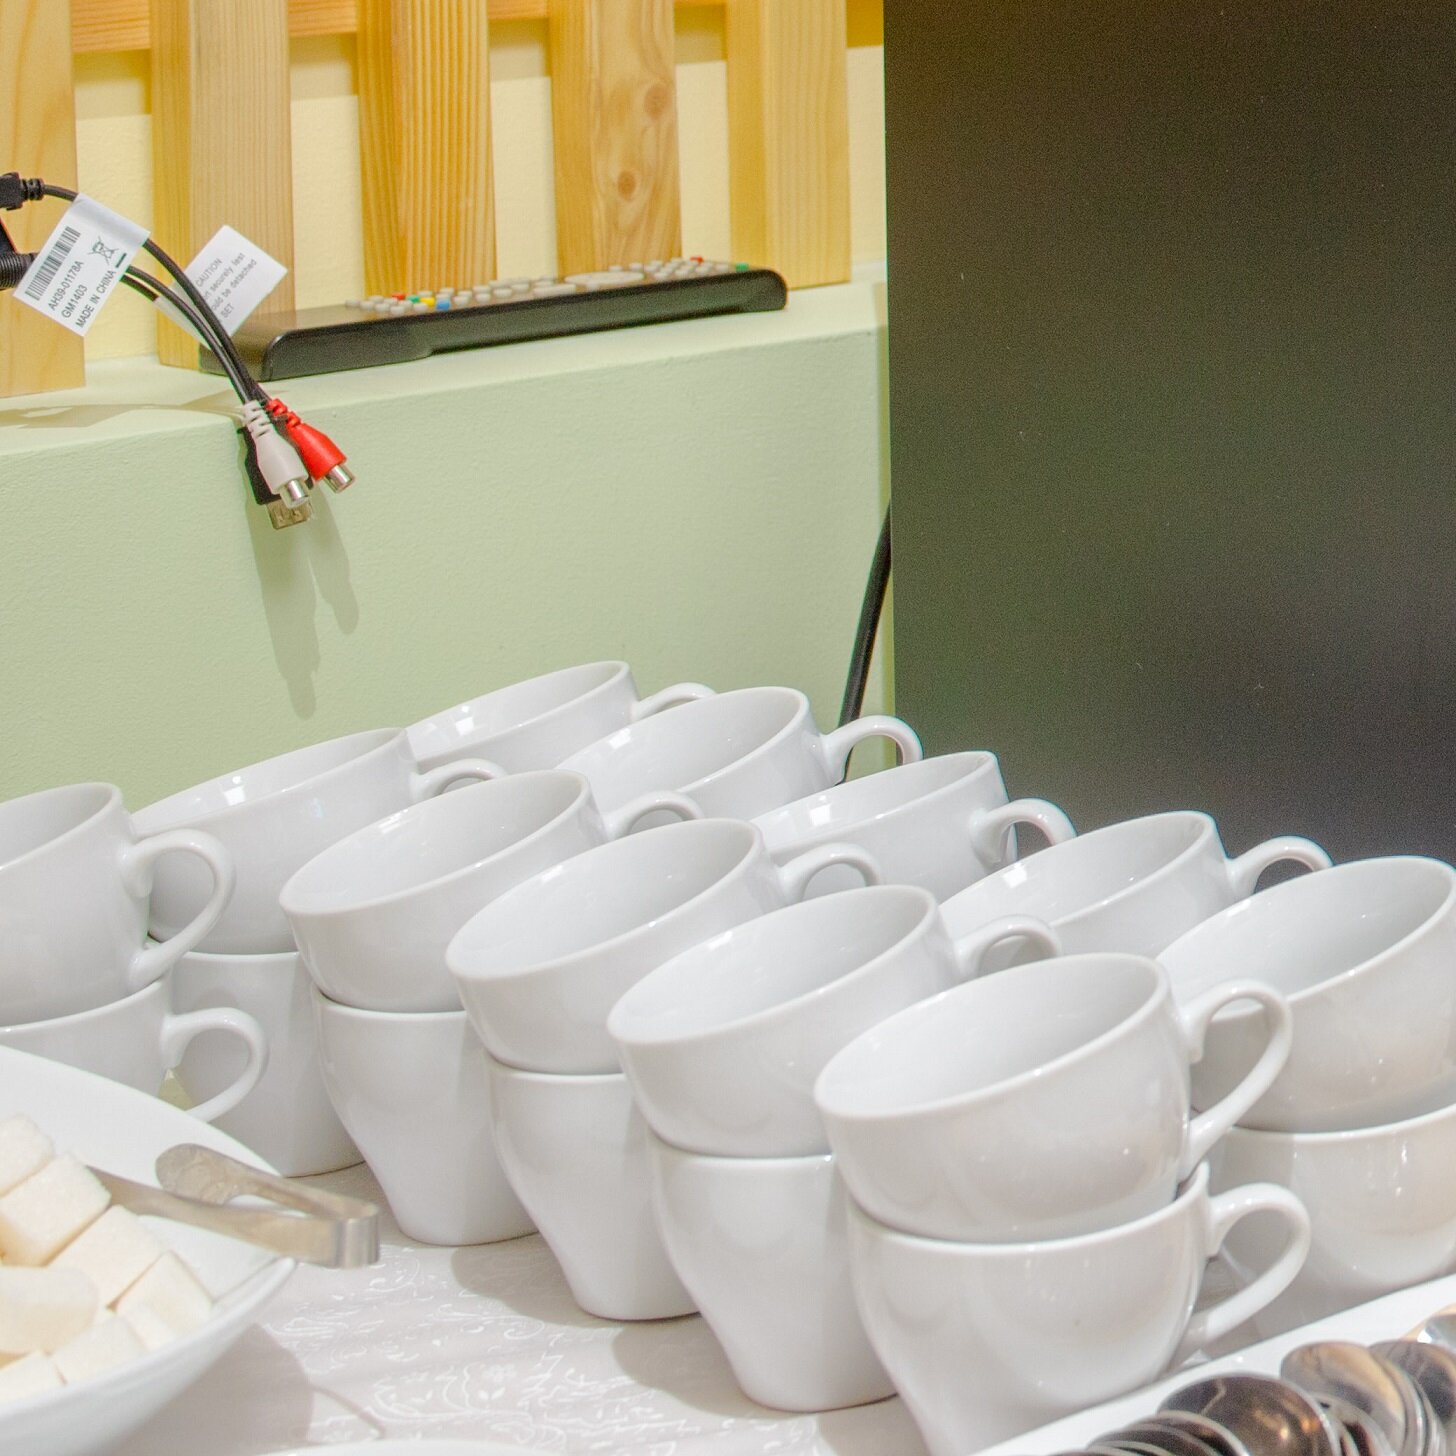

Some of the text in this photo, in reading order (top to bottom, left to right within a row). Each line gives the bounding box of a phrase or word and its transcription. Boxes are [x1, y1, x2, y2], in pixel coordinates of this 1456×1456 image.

[48, 260, 84, 311] AH39-01178A
[195, 257, 223, 287] CAUTION
[61, 284, 88, 319] GM1403
[75, 270, 117, 328] MADE IN CHINA
[220, 302, 235, 318] SET
